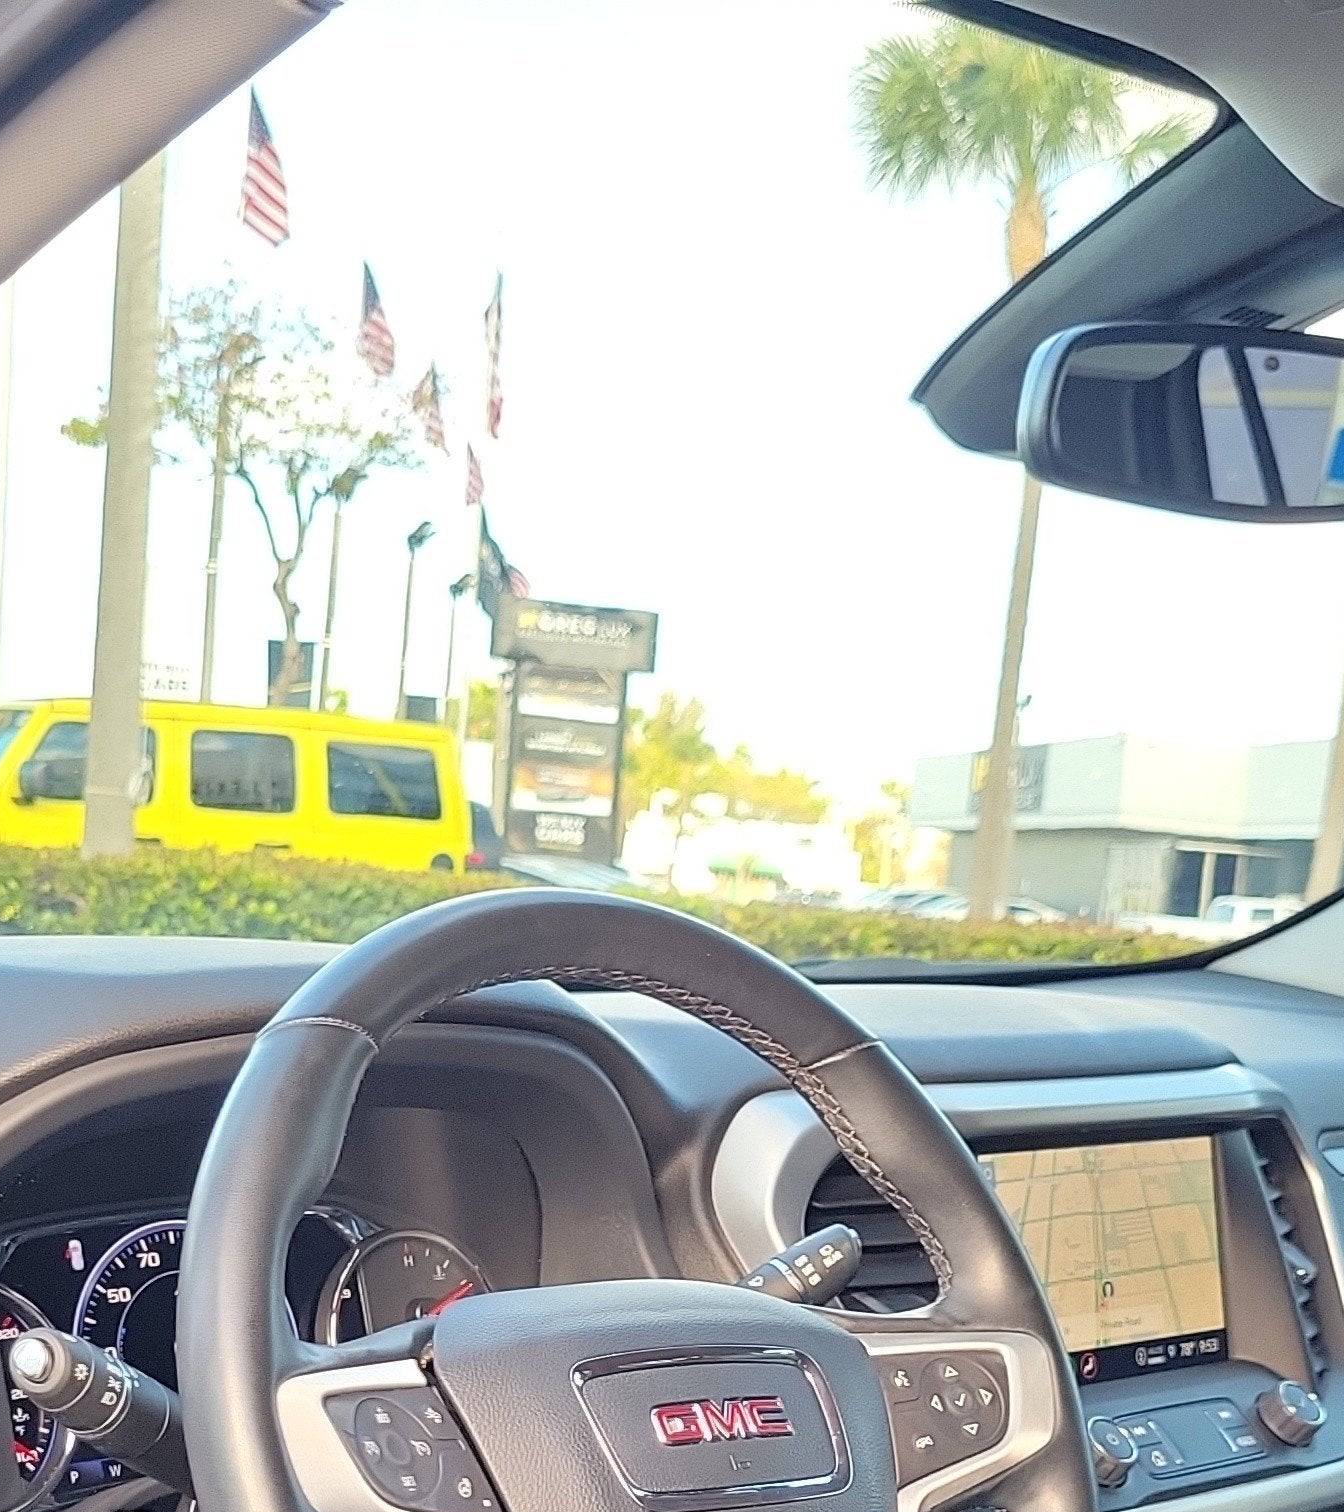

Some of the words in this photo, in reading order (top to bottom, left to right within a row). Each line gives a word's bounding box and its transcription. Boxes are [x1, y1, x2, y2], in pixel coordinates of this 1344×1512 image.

[136, 1252, 161, 1268] 70
[106, 1287, 132, 1303] 50
[650, 1395, 796, 1447] GMC
[69, 1470, 80, 1484] P
[108, 1464, 122, 1477] W
